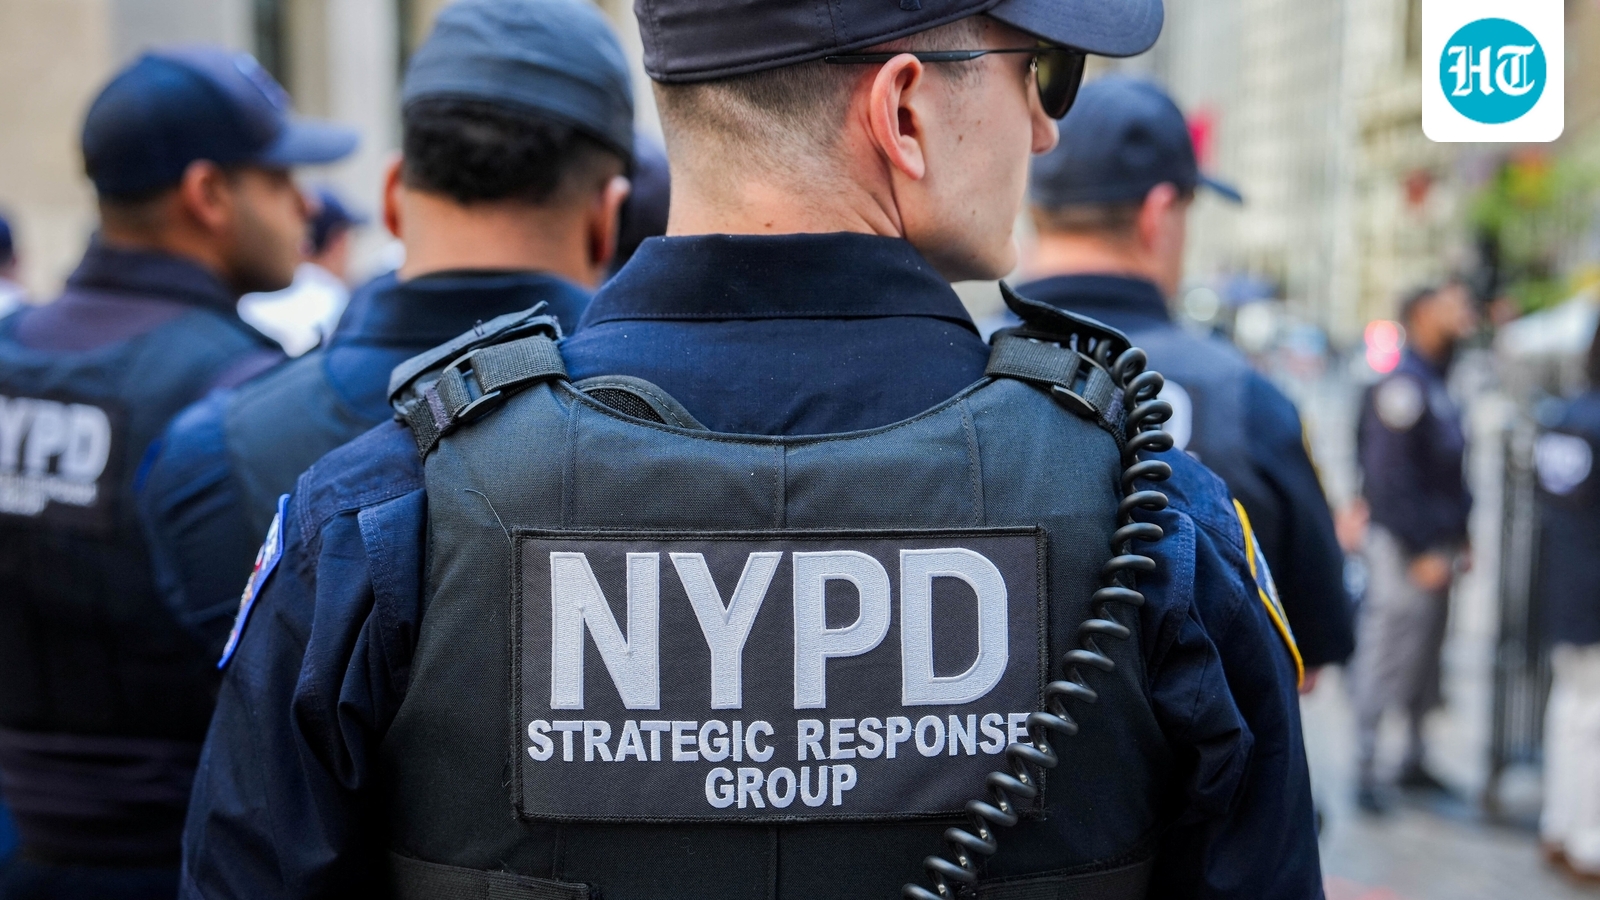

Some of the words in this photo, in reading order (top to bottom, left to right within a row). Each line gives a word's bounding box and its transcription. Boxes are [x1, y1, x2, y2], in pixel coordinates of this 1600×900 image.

[549, 547, 1009, 710] NYPD
[527, 720, 775, 763] STRATEGIC
[797, 712, 1034, 761] RESPONSE
[705, 764, 857, 809] GROUP
